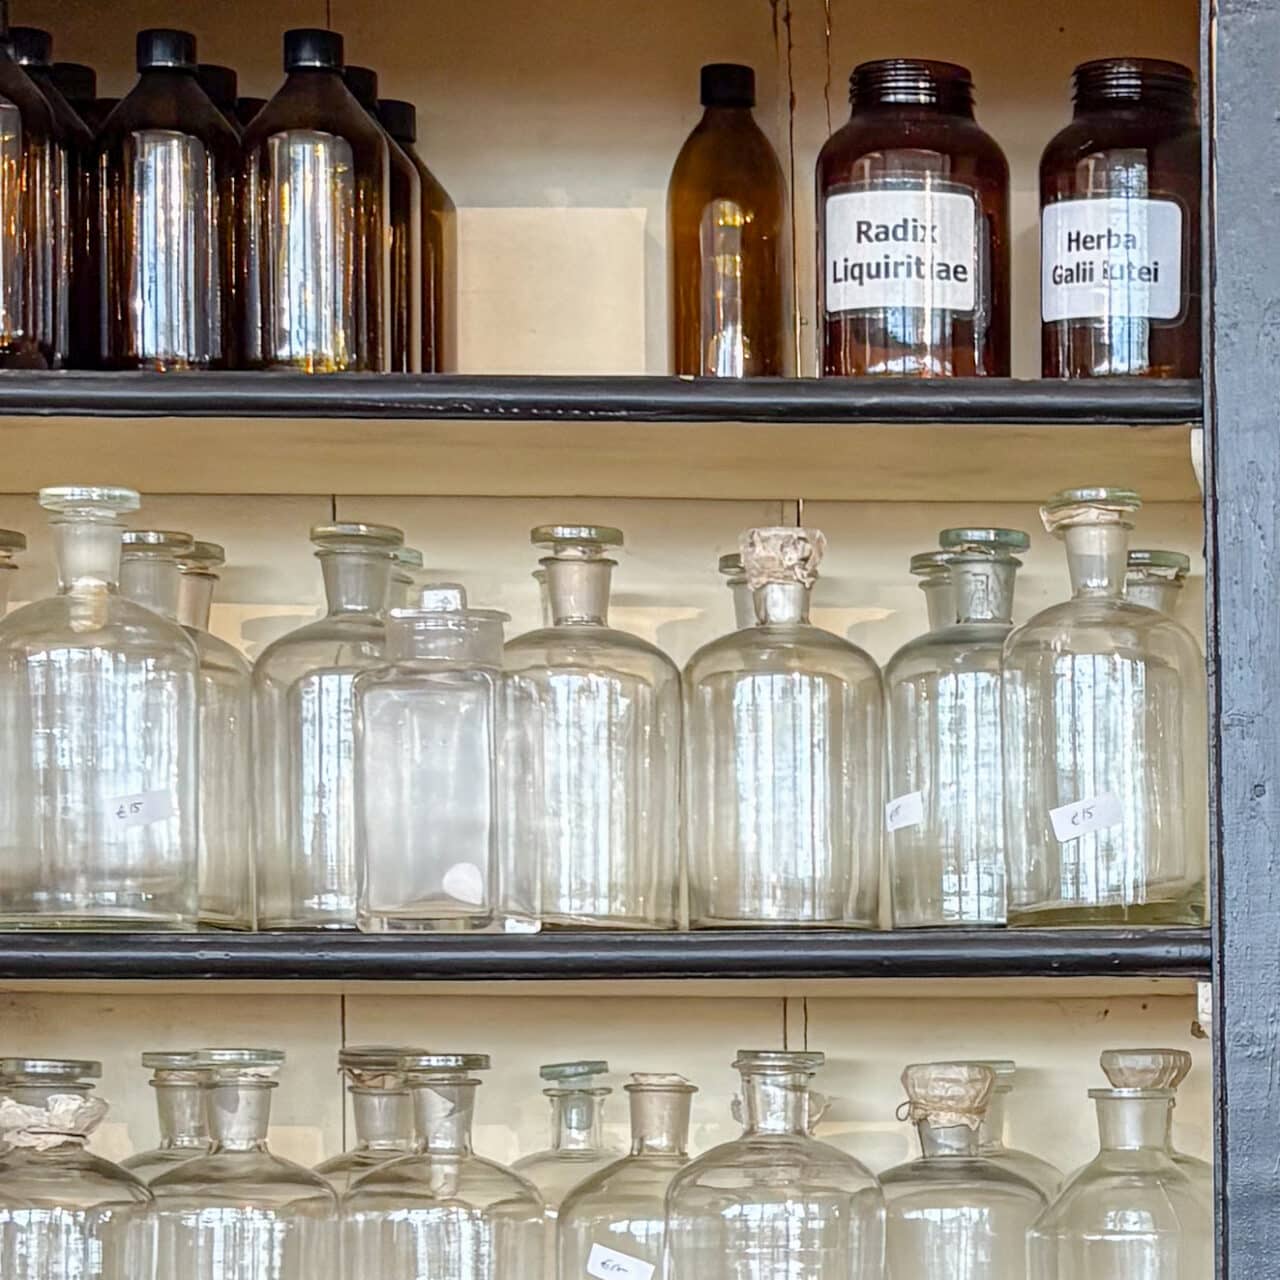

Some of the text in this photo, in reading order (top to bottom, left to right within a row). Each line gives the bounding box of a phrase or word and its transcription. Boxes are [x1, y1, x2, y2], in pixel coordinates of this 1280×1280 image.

[855, 218, 938, 245] Radix
[1066, 227, 1137, 253] Herba
[831, 255, 969, 286] Liquiritae
[1051, 260, 1095, 286] Galii
